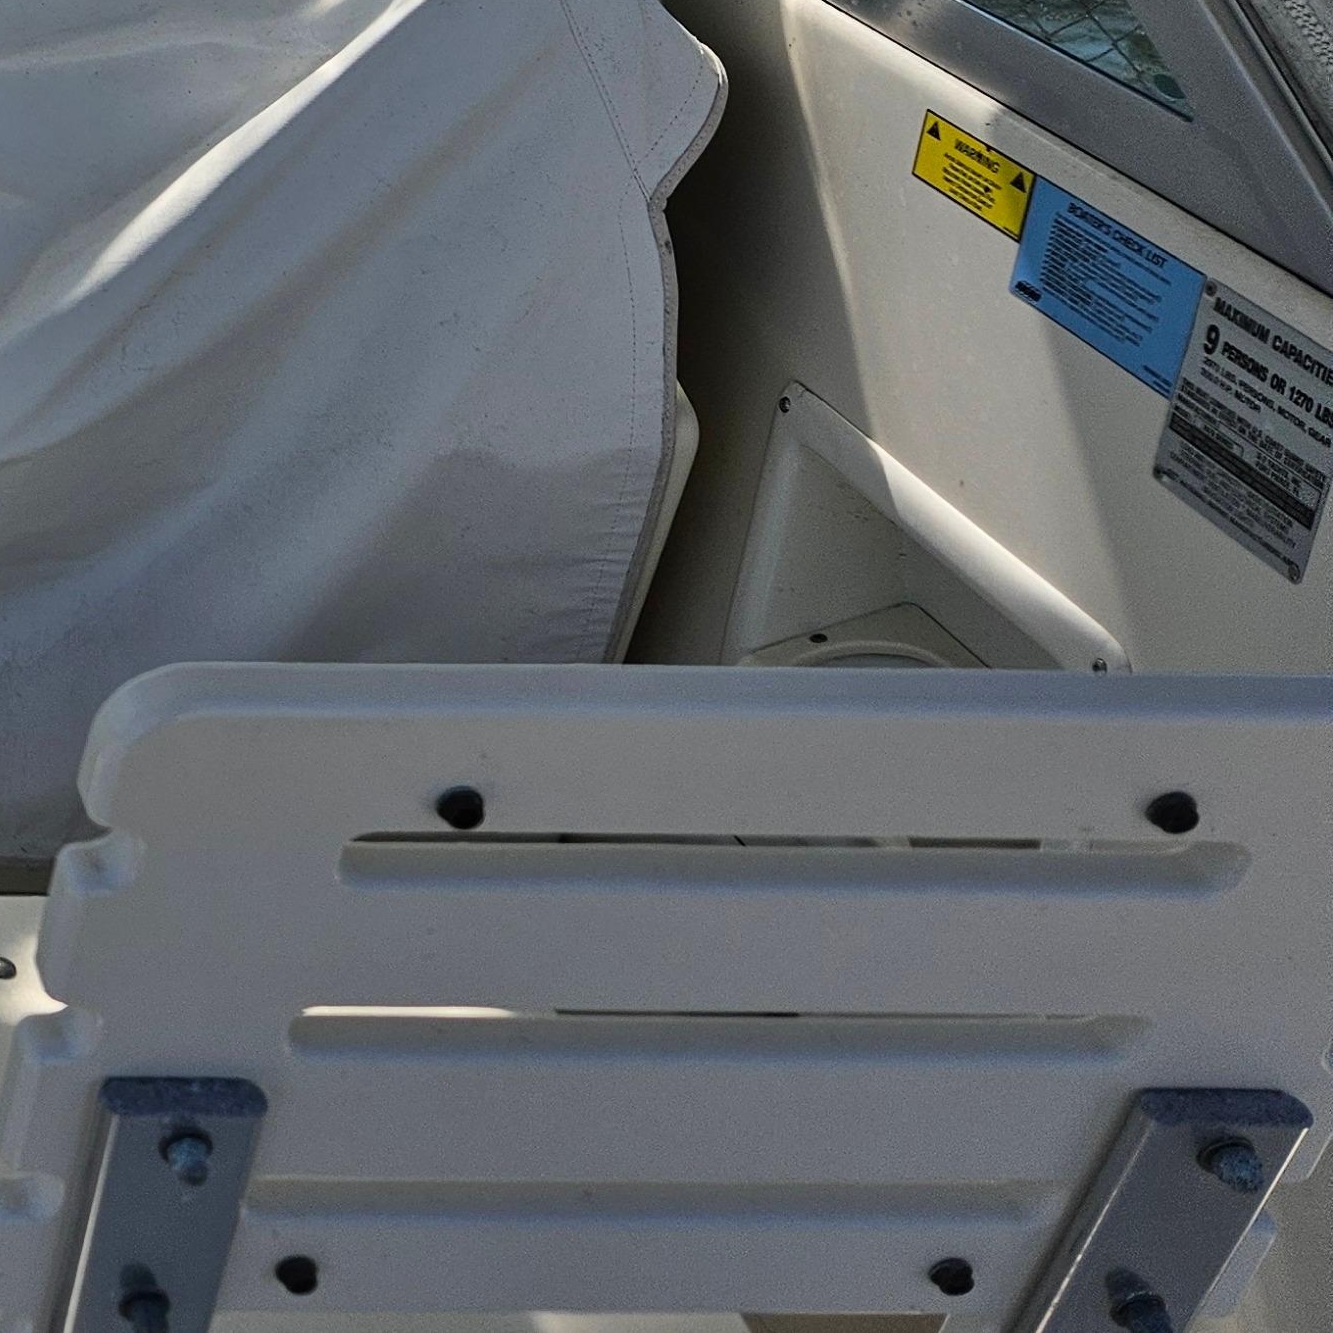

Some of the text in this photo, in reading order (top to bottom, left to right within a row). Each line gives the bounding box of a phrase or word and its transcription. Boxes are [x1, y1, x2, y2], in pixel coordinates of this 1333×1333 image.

[1113, 230, 1146, 255] CHECK
[1144, 249, 1168, 268] LIST
[1213, 297, 1270, 345] MAXIMUM
[1203, 324, 1221, 355] 9
[1221, 341, 1269, 383] PERSONS
[1270, 373, 1287, 396] OR
[1289, 386, 1314, 413] 1270
